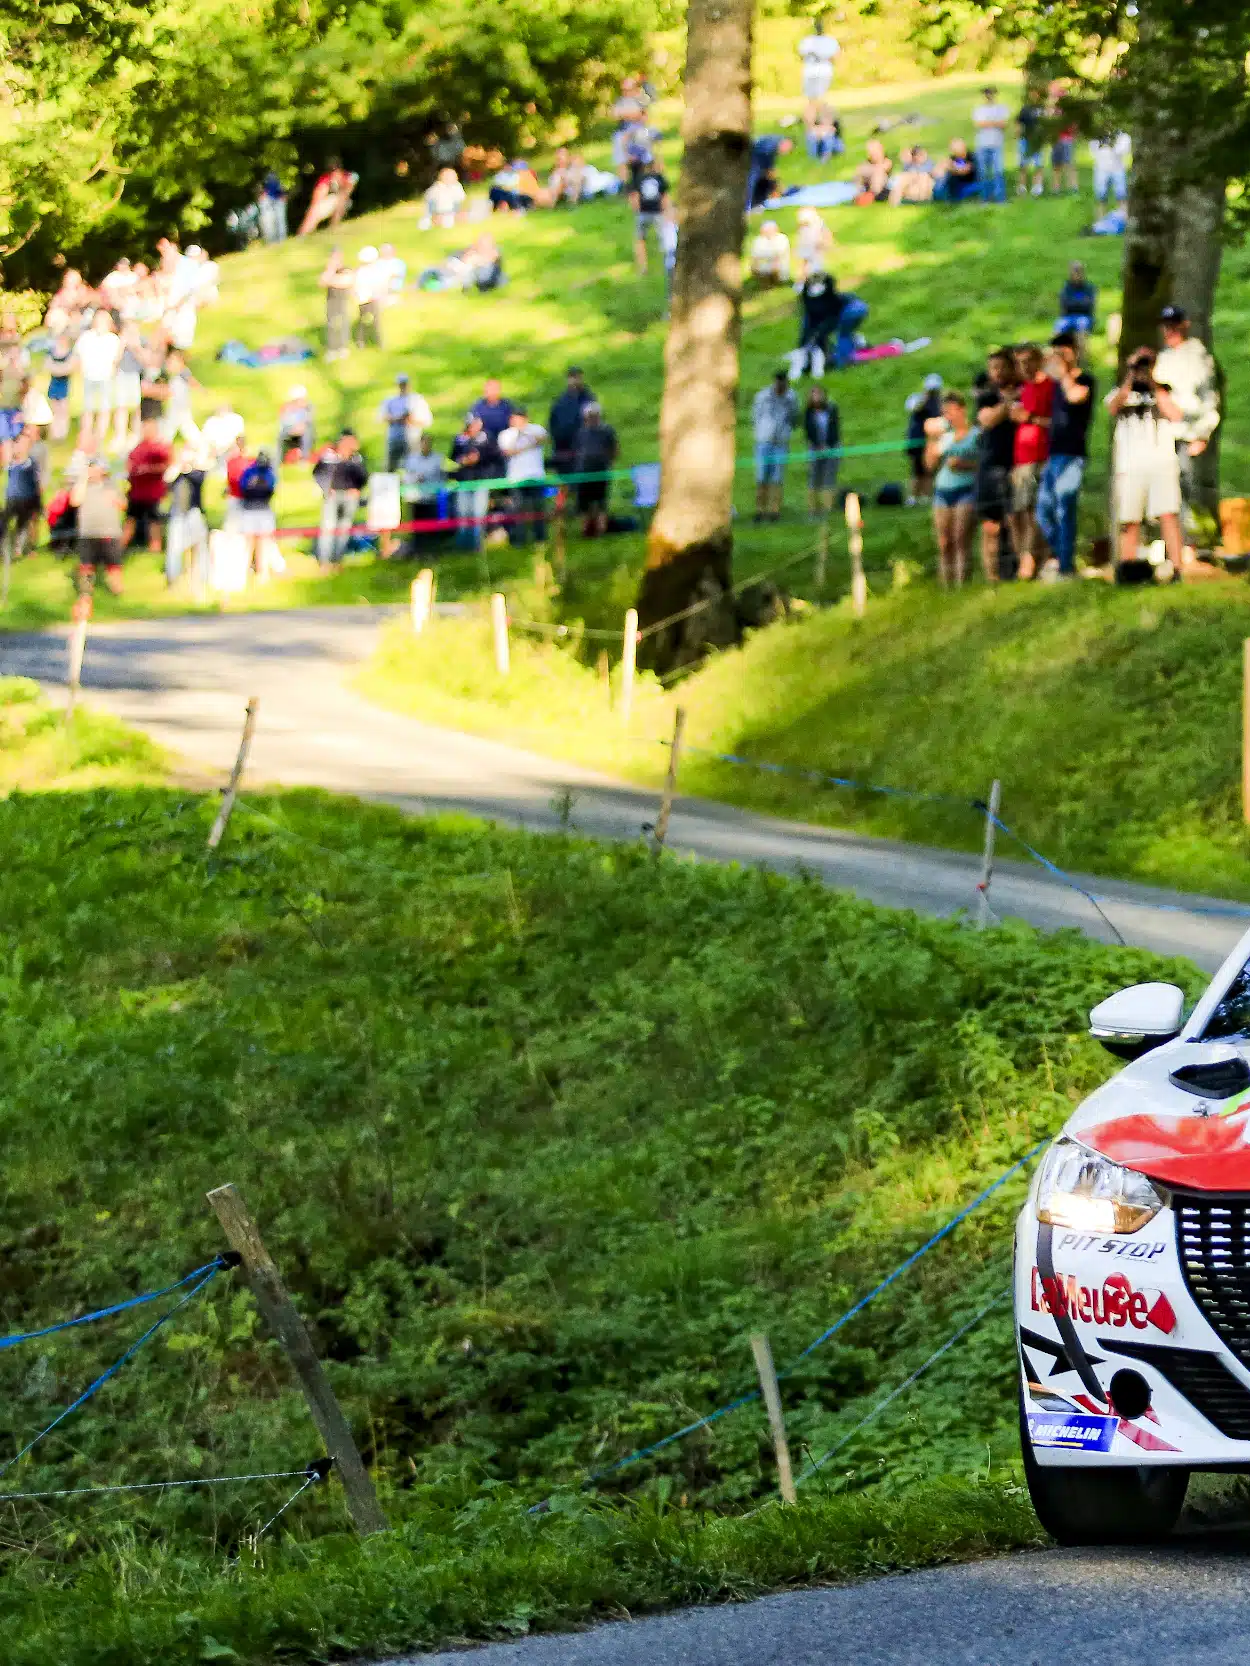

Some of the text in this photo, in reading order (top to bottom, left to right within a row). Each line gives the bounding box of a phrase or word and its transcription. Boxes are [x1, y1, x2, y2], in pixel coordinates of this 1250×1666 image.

[1058, 1234, 1101, 1251] PIT
[1099, 1239, 1166, 1259] STOP
[1035, 1424, 1102, 1441] MICHELIN
